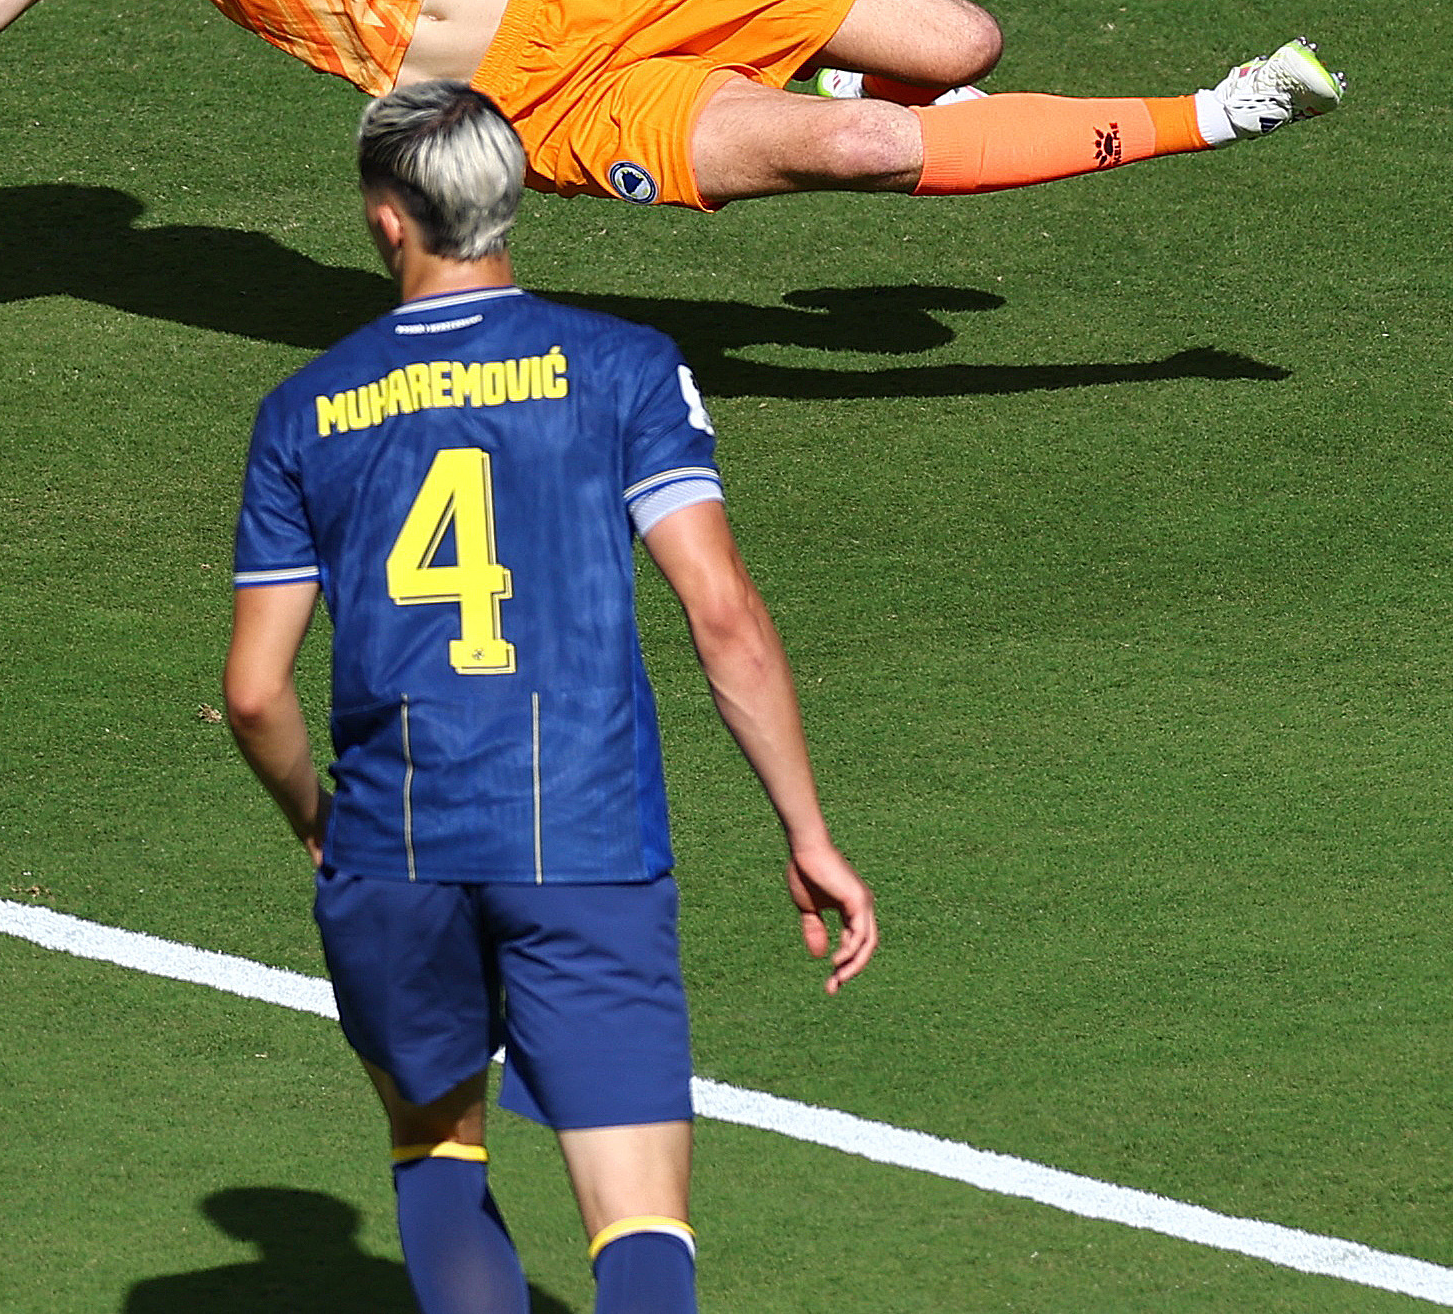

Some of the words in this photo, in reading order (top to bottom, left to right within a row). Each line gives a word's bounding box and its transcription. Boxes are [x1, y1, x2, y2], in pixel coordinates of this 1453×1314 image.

[1109, 122, 1121, 165] KELME
[315, 346, 569, 437] MUHAREMOVIĆ
[387, 447, 515, 674] 4
